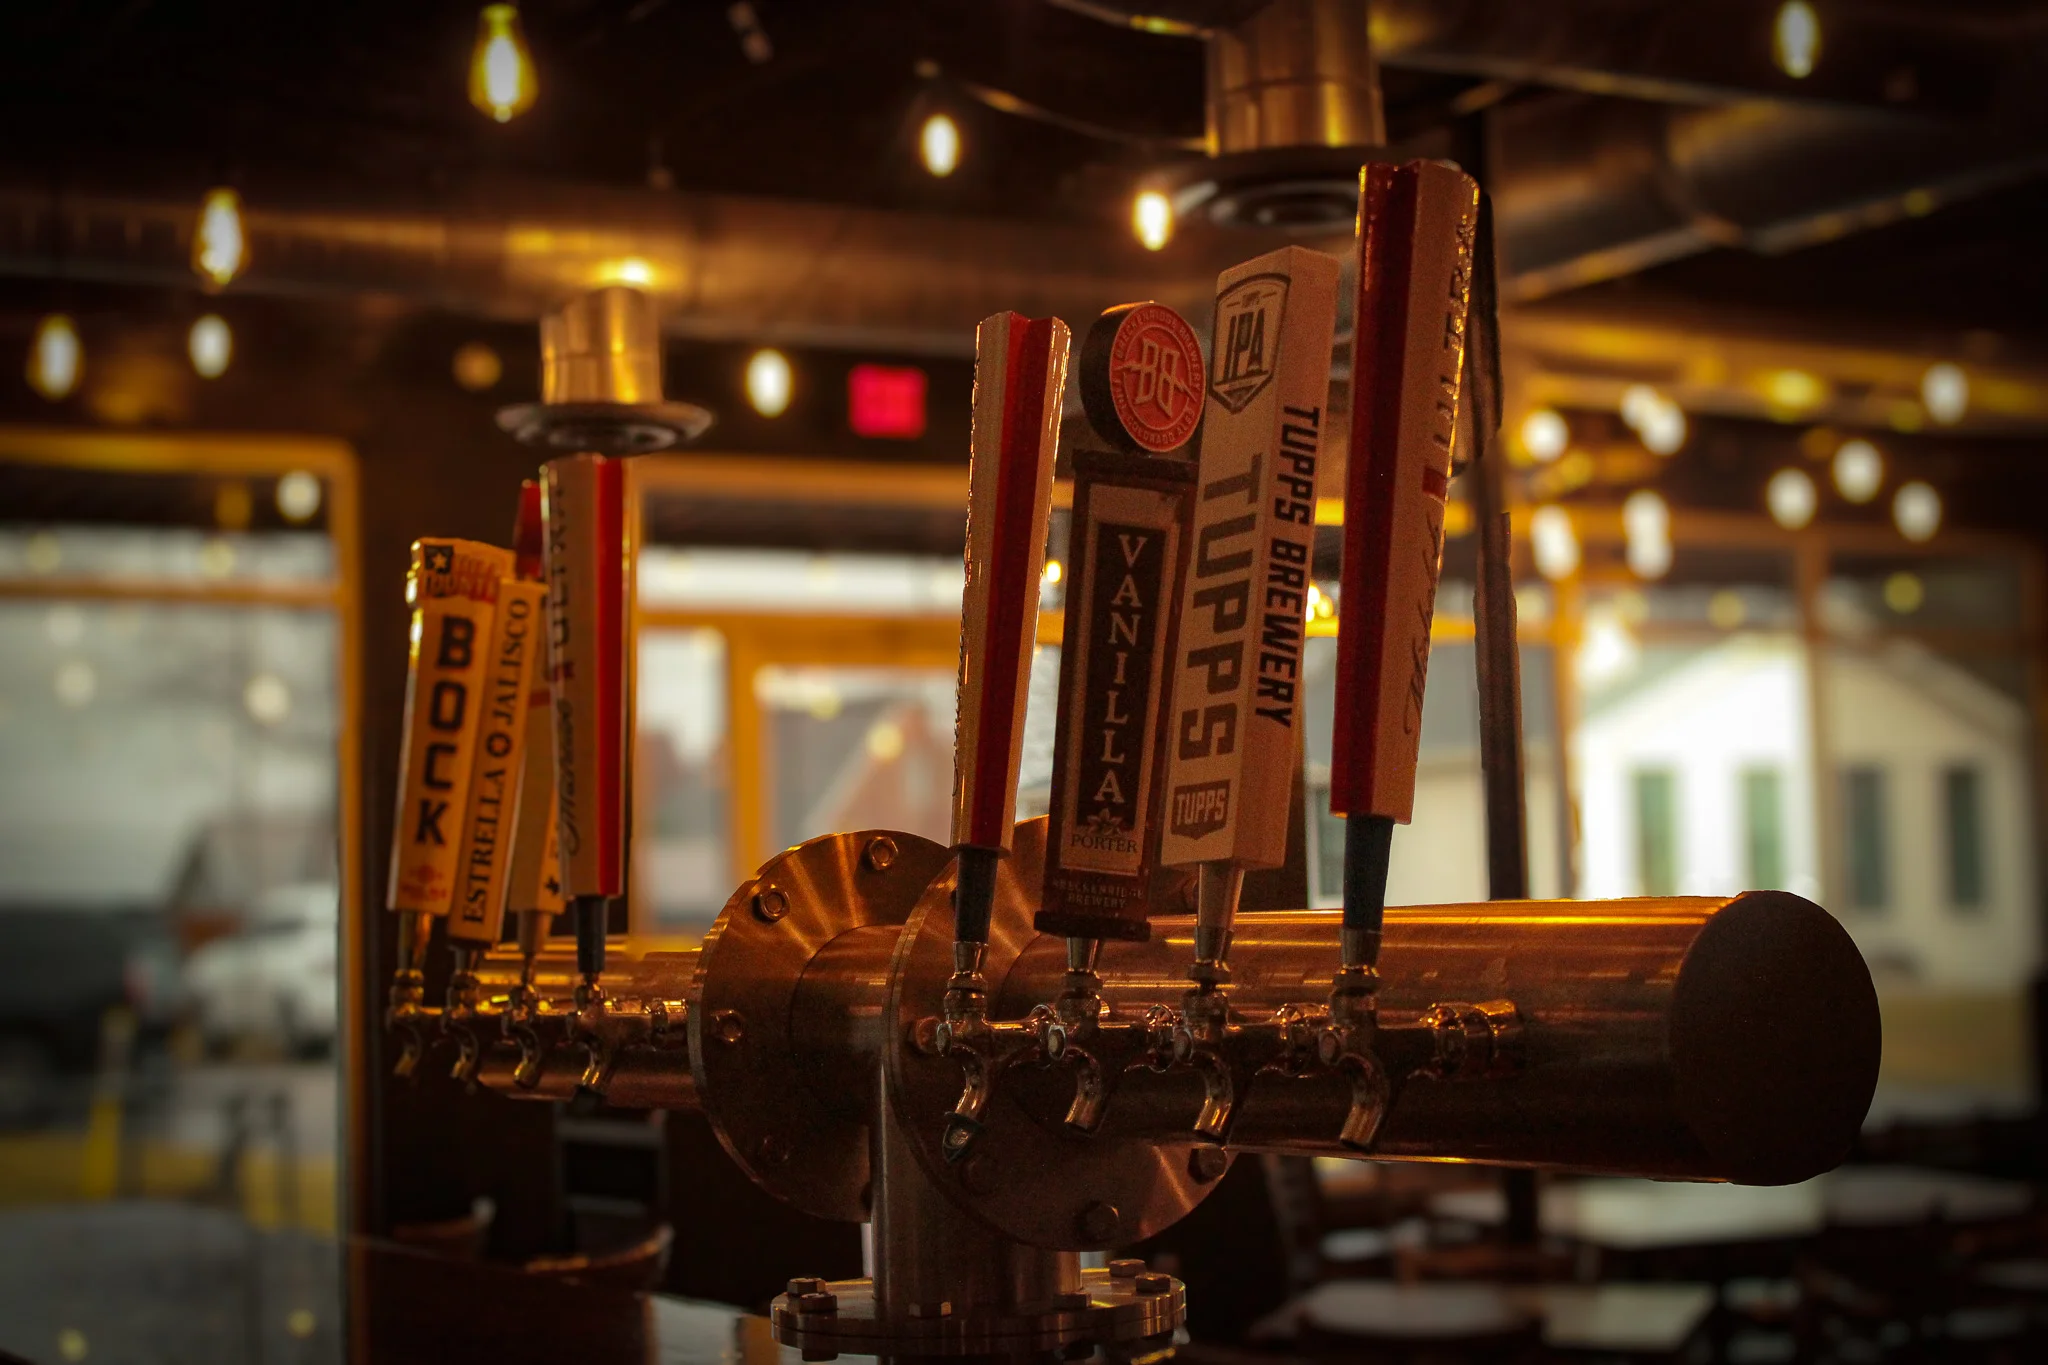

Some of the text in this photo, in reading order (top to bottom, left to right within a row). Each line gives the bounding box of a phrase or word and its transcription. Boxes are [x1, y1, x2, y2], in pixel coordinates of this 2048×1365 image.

[1223, 307, 1265, 381] IPA
[1093, 533, 1148, 805] VANILLA
[1179, 453, 1262, 761] TUPPS
[1256, 405, 1319, 728] TUPPS BREWERY
[415, 616, 476, 845] BOCK
[464, 598, 530, 925] ESTRELLA JALISCO
[1071, 833, 1138, 853] PORTER
[1175, 787, 1227, 825] TUPPS
